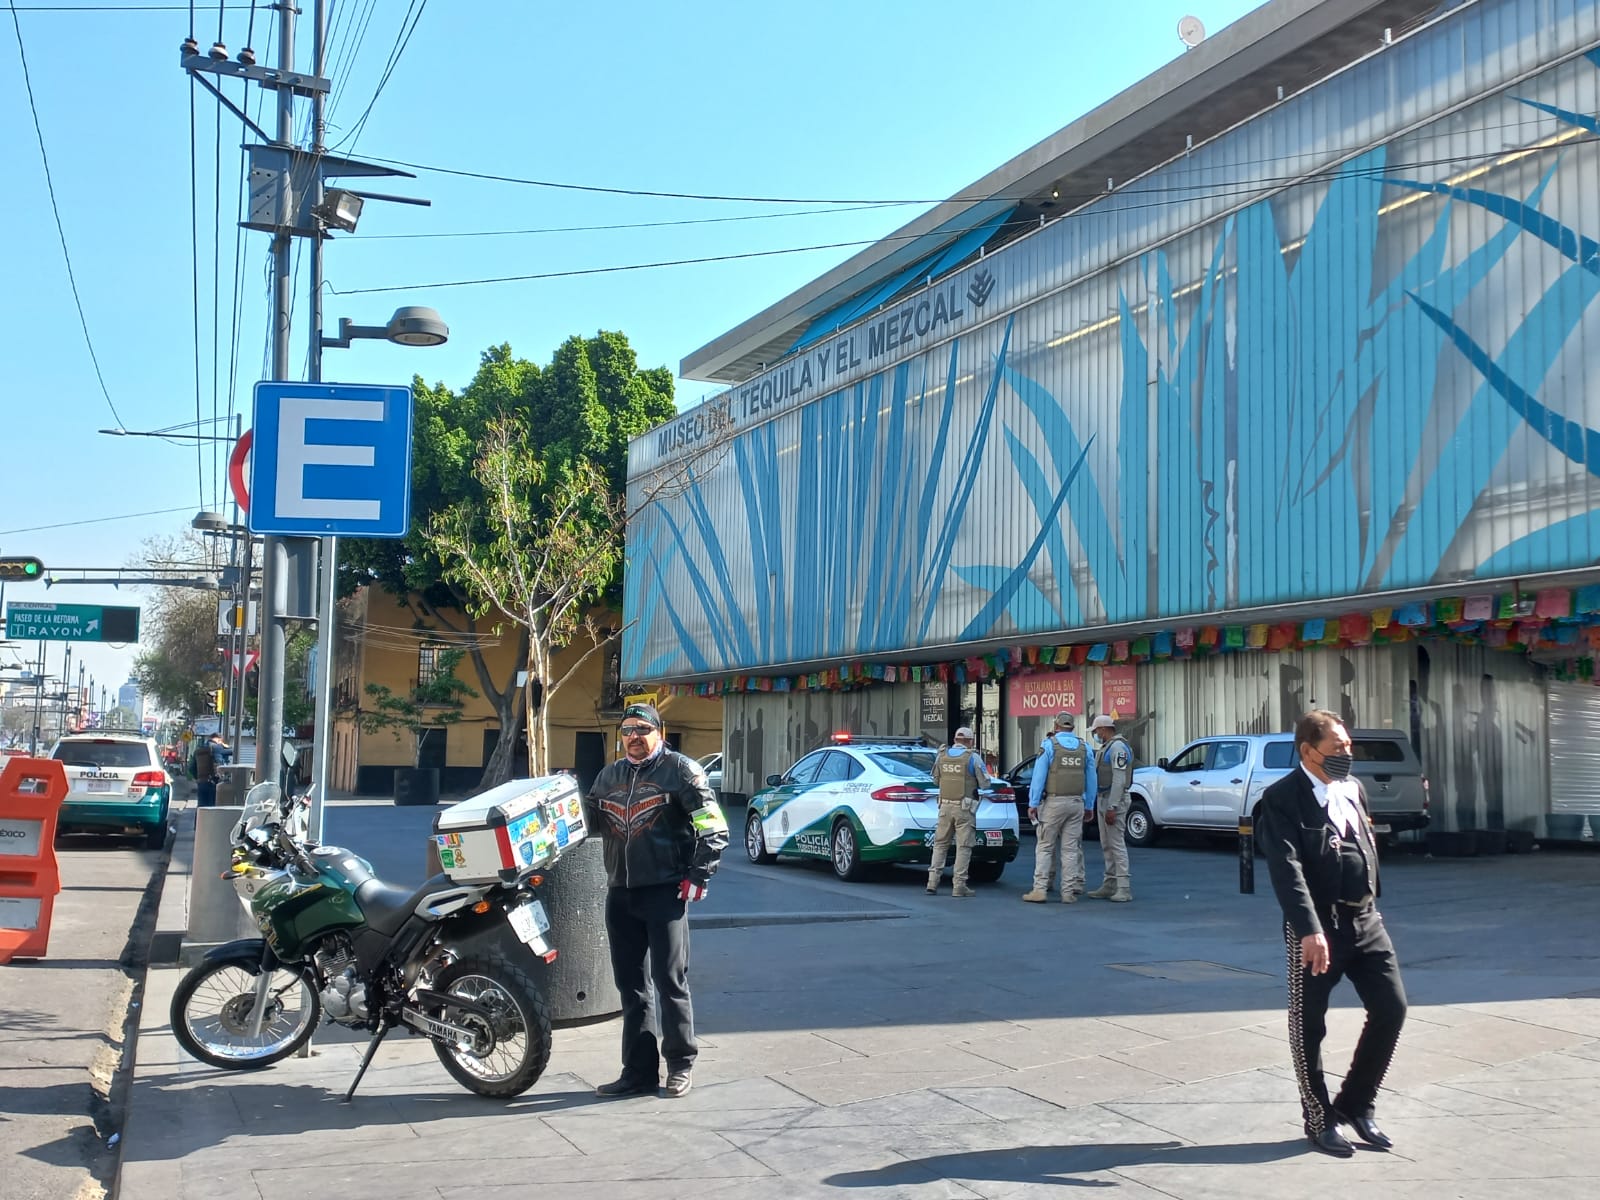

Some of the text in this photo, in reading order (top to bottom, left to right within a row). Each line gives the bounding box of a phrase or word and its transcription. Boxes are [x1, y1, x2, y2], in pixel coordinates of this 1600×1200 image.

[658, 416, 704, 457] MUSEO
[741, 360, 812, 418] TEQUILA
[818, 348, 831, 382] Y
[836, 337, 861, 375] EL
[869, 285, 963, 360] MEZCAL
[274, 397, 384, 520] E
[14, 613, 79, 625] PASEO DE LA REFORMA
[28, 626, 82, 636] RAYON
[1063, 680, 1074, 690] BAR
[1023, 692, 1075, 709] NO COVER
[923, 714, 943, 722] MEZCAL
[1061, 757, 1081, 766] SSC
[942, 764, 961, 773] SSC
[79, 771, 119, 779] POLICIA
[794, 834, 830, 848] POLICÍA
[427, 1021, 458, 1042] YAMAHA
